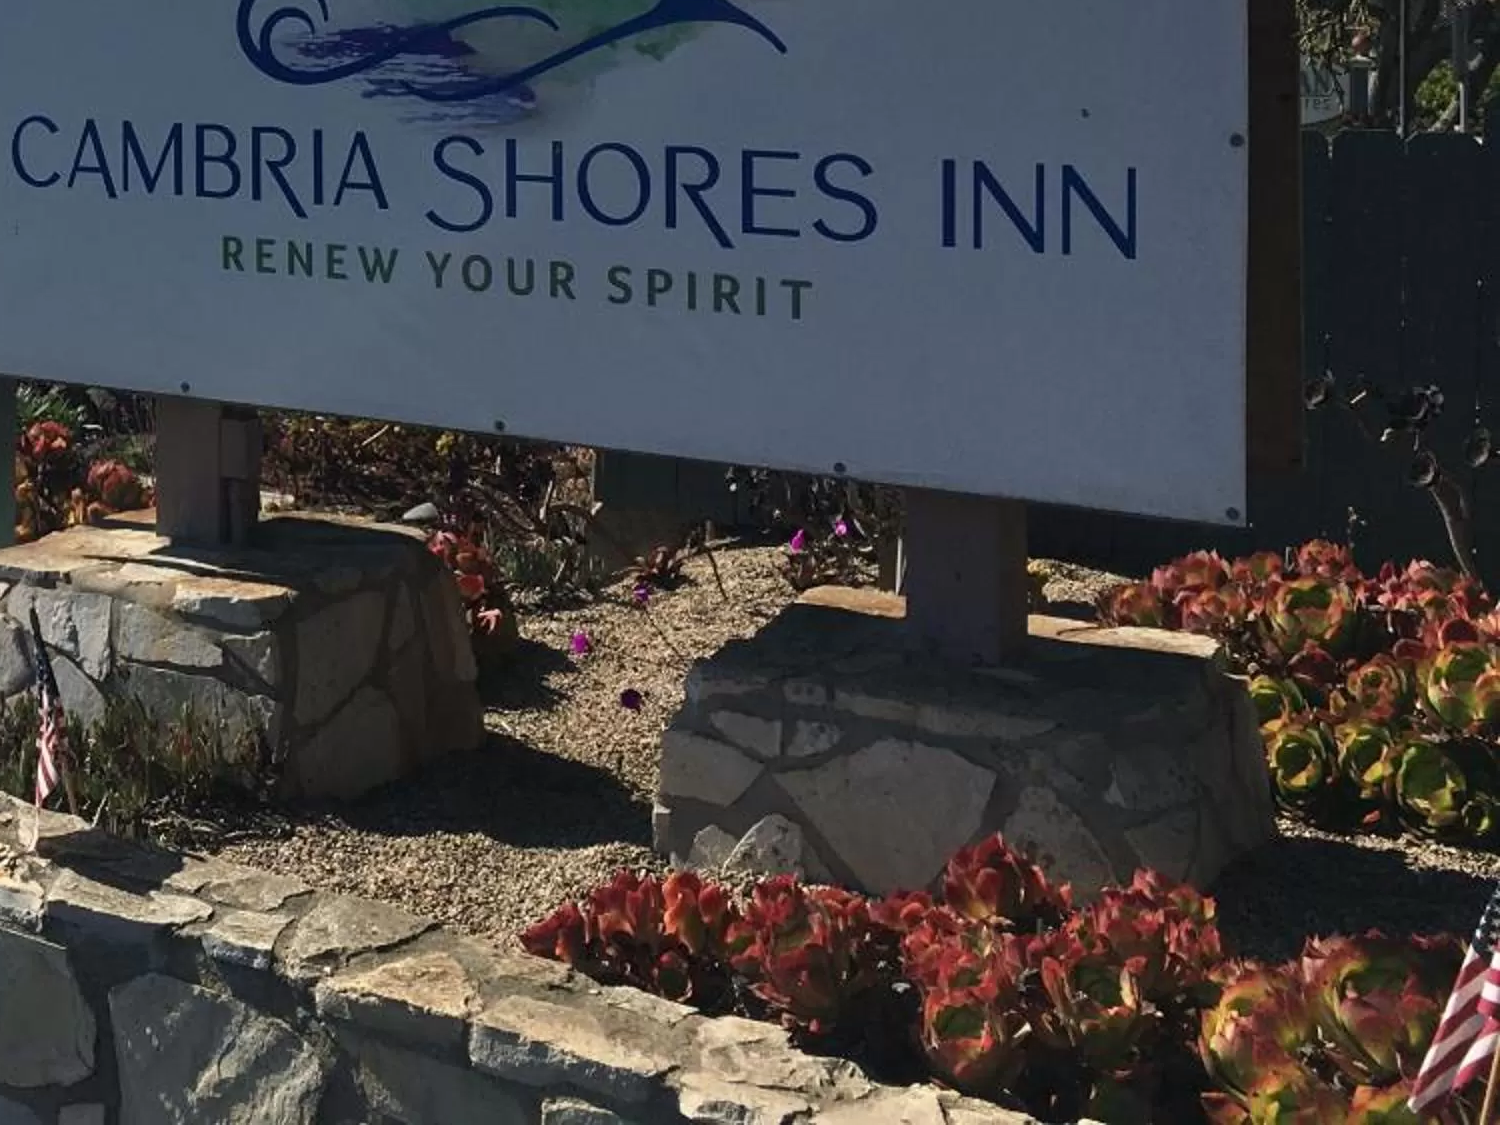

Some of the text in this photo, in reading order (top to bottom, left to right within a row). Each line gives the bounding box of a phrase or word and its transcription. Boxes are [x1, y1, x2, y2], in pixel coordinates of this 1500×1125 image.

[11, 115, 1137, 260] CAMBRIA SHORES INN
[222, 235, 813, 320] RENEW YOUR SPIRIT
